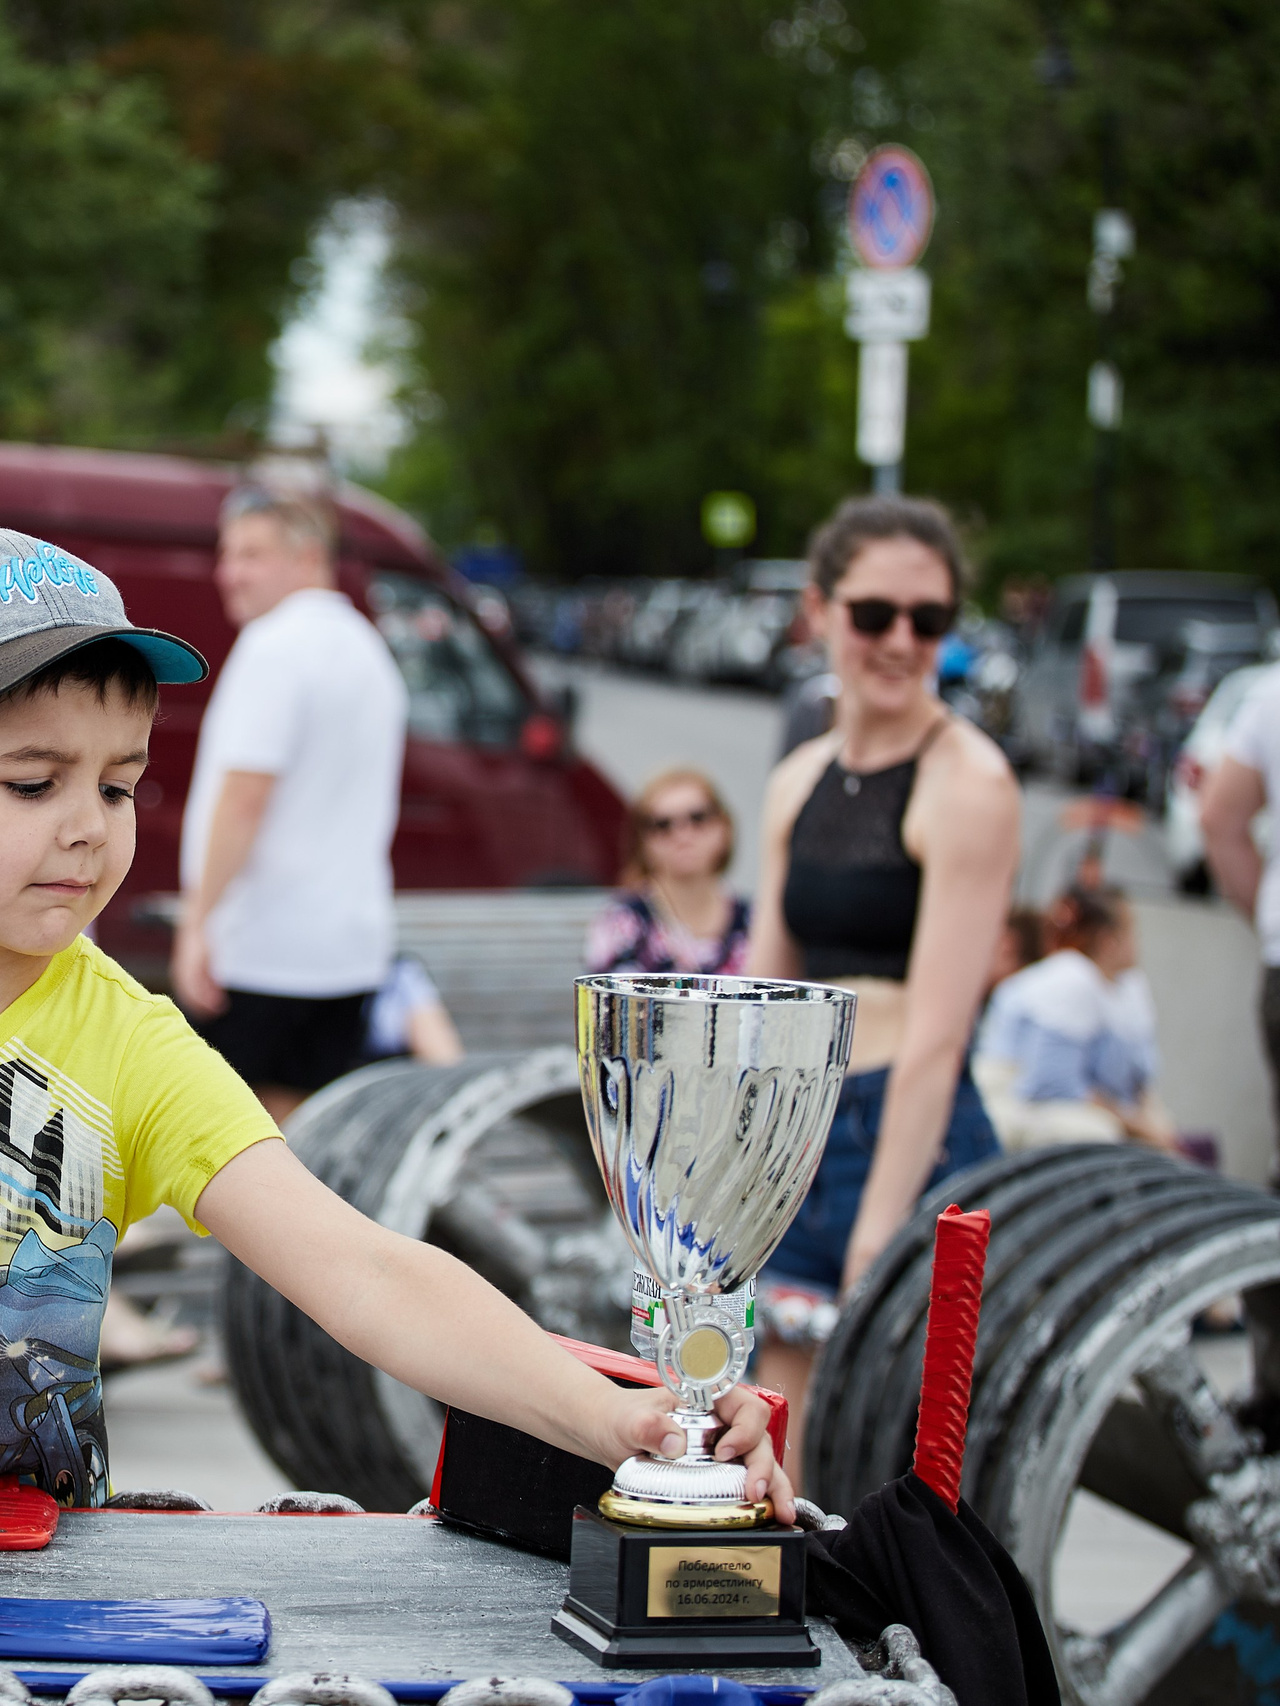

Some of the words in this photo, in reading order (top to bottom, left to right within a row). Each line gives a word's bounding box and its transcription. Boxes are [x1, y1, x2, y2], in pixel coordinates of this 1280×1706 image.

[678, 1560, 751, 1572] Победителю
[665, 1580, 680, 1588] по
[684, 1578, 763, 1590] армрестлингу
[677, 1594, 739, 1605] 16.06.2024
[742, 1595, 750, 1604] г.
